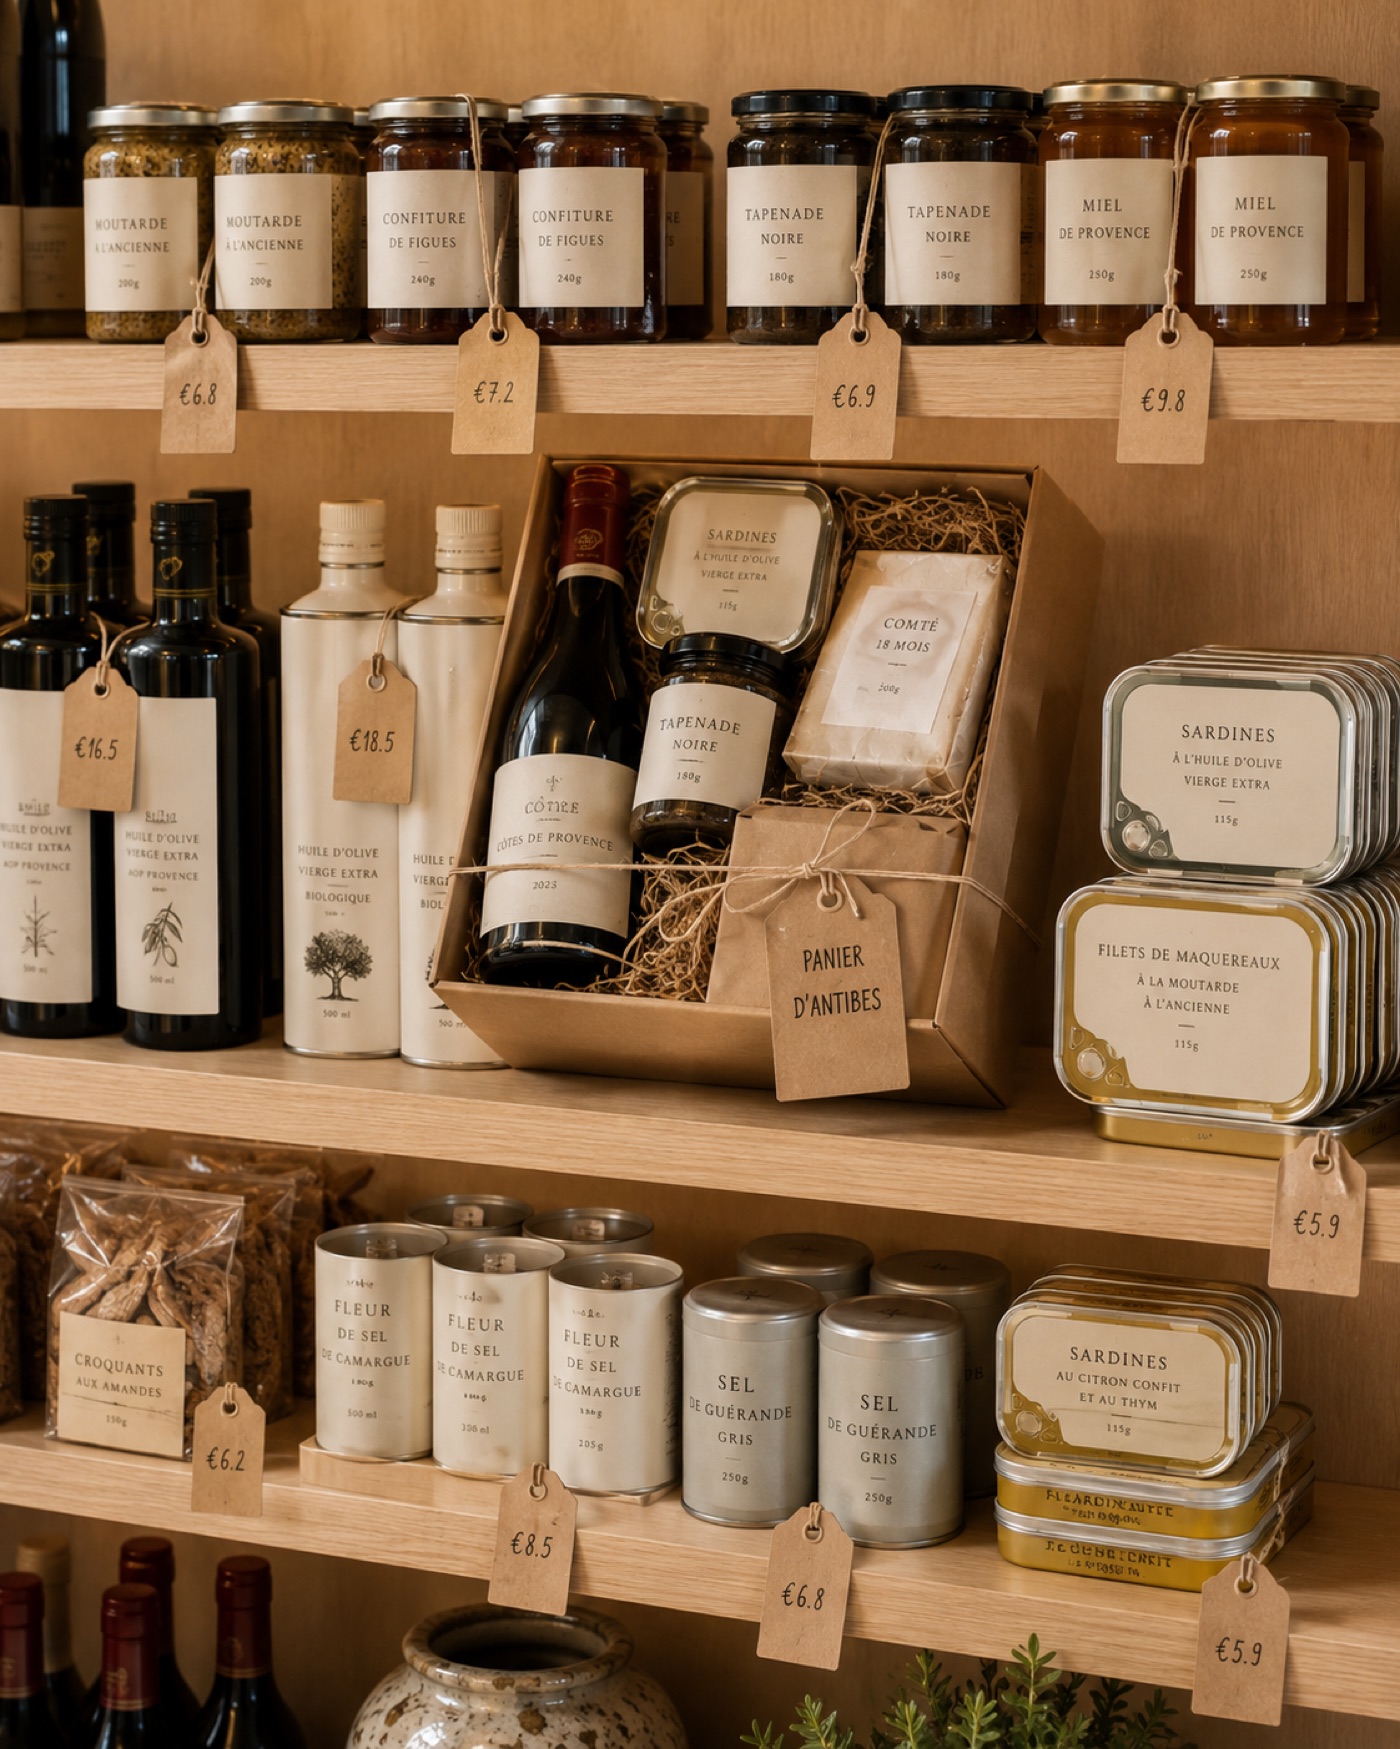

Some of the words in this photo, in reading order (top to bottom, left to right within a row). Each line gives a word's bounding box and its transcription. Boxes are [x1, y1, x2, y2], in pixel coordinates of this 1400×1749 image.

[1083, 198, 1122, 212] MIEL
[1235, 197, 1275, 210] MIEL
[383, 212, 466, 225] CONFITURE
[533, 210, 615, 224] CONFITURE
[745, 207, 824, 221] TAPENADE
[907, 205, 991, 218] TAPENADE
[96, 218, 167, 231] MOUTARDE
[227, 215, 302, 227] MOUTARDE
[761, 233, 804, 245] NOIRE
[926, 231, 970, 242] NOIRE
[1059, 227, 1073, 239] DE
[1077, 226, 1152, 239] PROVENCE
[1211, 226, 1225, 238] DE
[1230, 226, 1304, 238] PROVENCE
[389, 237, 404, 248] DE
[409, 237, 456, 248] FIGUES
[539, 235, 552, 247] DE
[557, 234, 603, 246] FIGUES
[250, 277, 272, 288] 200g
[411, 275, 435, 287] 240g
[558, 274, 582, 285] 240g
[770, 272, 794, 284] 180g
[936, 271, 960, 283] 180g
[1089, 269, 1114, 282] 250g
[1240, 269, 1267, 282] 250g
[179, 383, 217, 406] €6.8
[473, 380, 513, 403] €7.2
[832, 384, 875, 408] €6.9
[1140, 388, 1185, 412] €9.8
[707, 529, 777, 544] SARDINES
[741, 554, 780, 566] D'OLIVE
[701, 569, 734, 580] VIERGE
[738, 571, 767, 581] EXTRA
[884, 617, 938, 631] COMTÉ
[893, 641, 930, 652] MOIS
[660, 716, 740, 735] TAPENADE
[1182, 724, 1274, 742] SARDINES
[75, 736, 118, 760] €16.5
[349, 728, 395, 753] €18.5
[673, 739, 718, 752] NOIRE
[1185, 753, 1229, 766] L'HUILE
[1234, 756, 1282, 769] D'OLIVE
[1184, 776, 1227, 787] VIERGE
[1232, 778, 1269, 790] EXTRA
[1215, 815, 1238, 827] 115g
[157, 833, 199, 844] D'OLIVE
[528, 833, 543, 843] DE
[548, 832, 613, 851] PROVENCE
[164, 851, 198, 861] EXTRA
[298, 845, 328, 857] HUILE
[333, 848, 378, 858] D'OLIVE
[413, 854, 444, 865] HUILE
[298, 866, 337, 877] VIERGE
[342, 869, 378, 879] EXTRA
[306, 891, 371, 905] BIOLOGIQUE
[803, 945, 864, 972] PANIER
[1099, 943, 1145, 959] FILETS
[1152, 948, 1170, 961] DE
[1176, 950, 1279, 970] MAQUEREAUX
[1149, 976, 1164, 987] LA
[1169, 978, 1239, 993] MOUTARDE
[794, 988, 881, 1019] D'ANTIBES
[1157, 999, 1229, 1014] L'ANCIENNE
[1175, 1039, 1198, 1052] 115g
[1293, 1210, 1339, 1239] €5.9
[335, 1299, 391, 1317] FLEUR
[449, 1314, 504, 1331] FLEUR
[337, 1327, 355, 1341] DE
[361, 1330, 387, 1342] SEL
[565, 1329, 620, 1348] FLEUR
[451, 1341, 468, 1355] DE
[474, 1345, 499, 1356] SEL
[75, 1353, 163, 1377] CROQUANTS
[336, 1352, 410, 1367] CAMARGUE
[567, 1356, 585, 1371] DE
[590, 1361, 616, 1372] SEL
[1070, 1346, 1167, 1370] SARDINES
[448, 1366, 524, 1382] CAMARGUE
[76, 1377, 98, 1389] AUX
[102, 1381, 161, 1398] AMANDES
[718, 1375, 754, 1392] SEL
[1057, 1371, 1073, 1381] AU
[1078, 1373, 1127, 1387] CITRON
[1133, 1380, 1181, 1393] CONFIT
[565, 1382, 641, 1398] CAMARGUE
[690, 1396, 701, 1412] DE
[705, 1403, 791, 1421] GUÉRANDE
[861, 1394, 898, 1411] SEL
[1080, 1392, 1095, 1403] ET
[1098, 1396, 1116, 1405] AU
[1121, 1397, 1157, 1410] THYM
[828, 1416, 842, 1432] DE
[847, 1423, 936, 1440] GUÉRANDE
[1107, 1424, 1131, 1436] 115g
[718, 1431, 753, 1446] GRIS
[206, 1447, 245, 1471] €6.2
[861, 1451, 897, 1465] GRIS
[722, 1472, 749, 1485] 250g
[865, 1492, 892, 1506] 250g
[510, 1531, 553, 1558] €8.5
[781, 1582, 825, 1611] €6.8
[1215, 1637, 1262, 1666] €5.9
